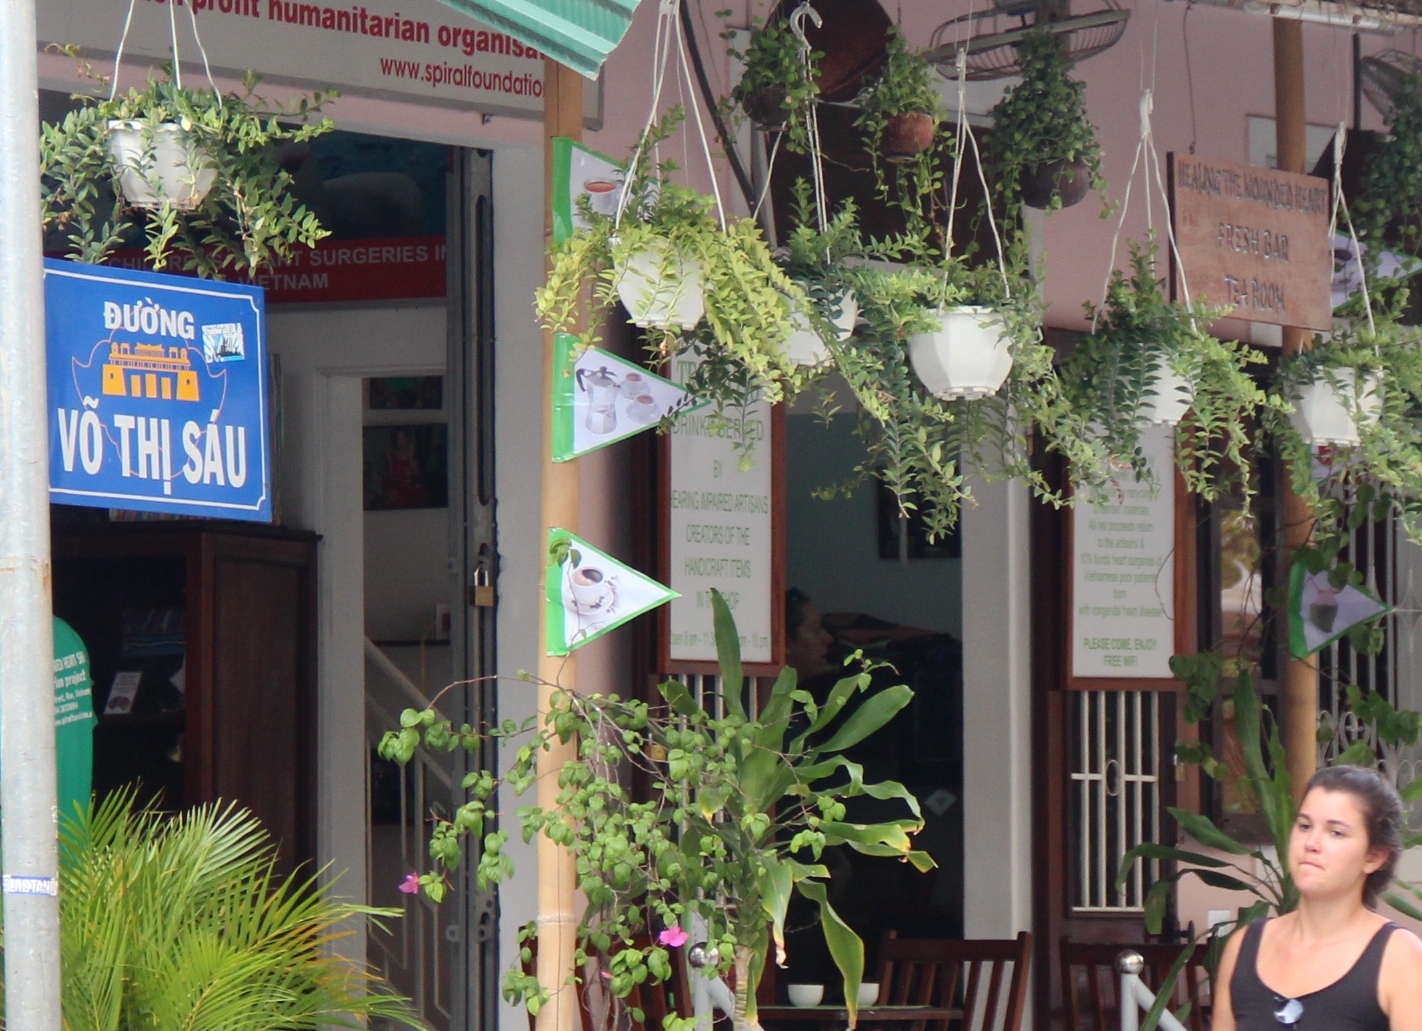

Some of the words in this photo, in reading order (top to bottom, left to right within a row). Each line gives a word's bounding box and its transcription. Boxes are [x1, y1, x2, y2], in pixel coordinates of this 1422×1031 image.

[268, 0, 430, 44] humanitarian
[437, 25, 546, 60] organisa
[380, 57, 544, 98] www.spiralfoundatio
[309, 243, 428, 266] SURGERIES
[1217, 221, 1260, 255] FRESH
[1264, 229, 1289, 263] BAR
[1224, 274, 1250, 307] TEA
[1251, 277, 1286, 315] ROOM
[102, 296, 195, 340] ĐƯỜNG
[57, 395, 103, 476] VÕ
[113, 413, 172, 495] THỊ
[182, 408, 247, 489] SÁU
